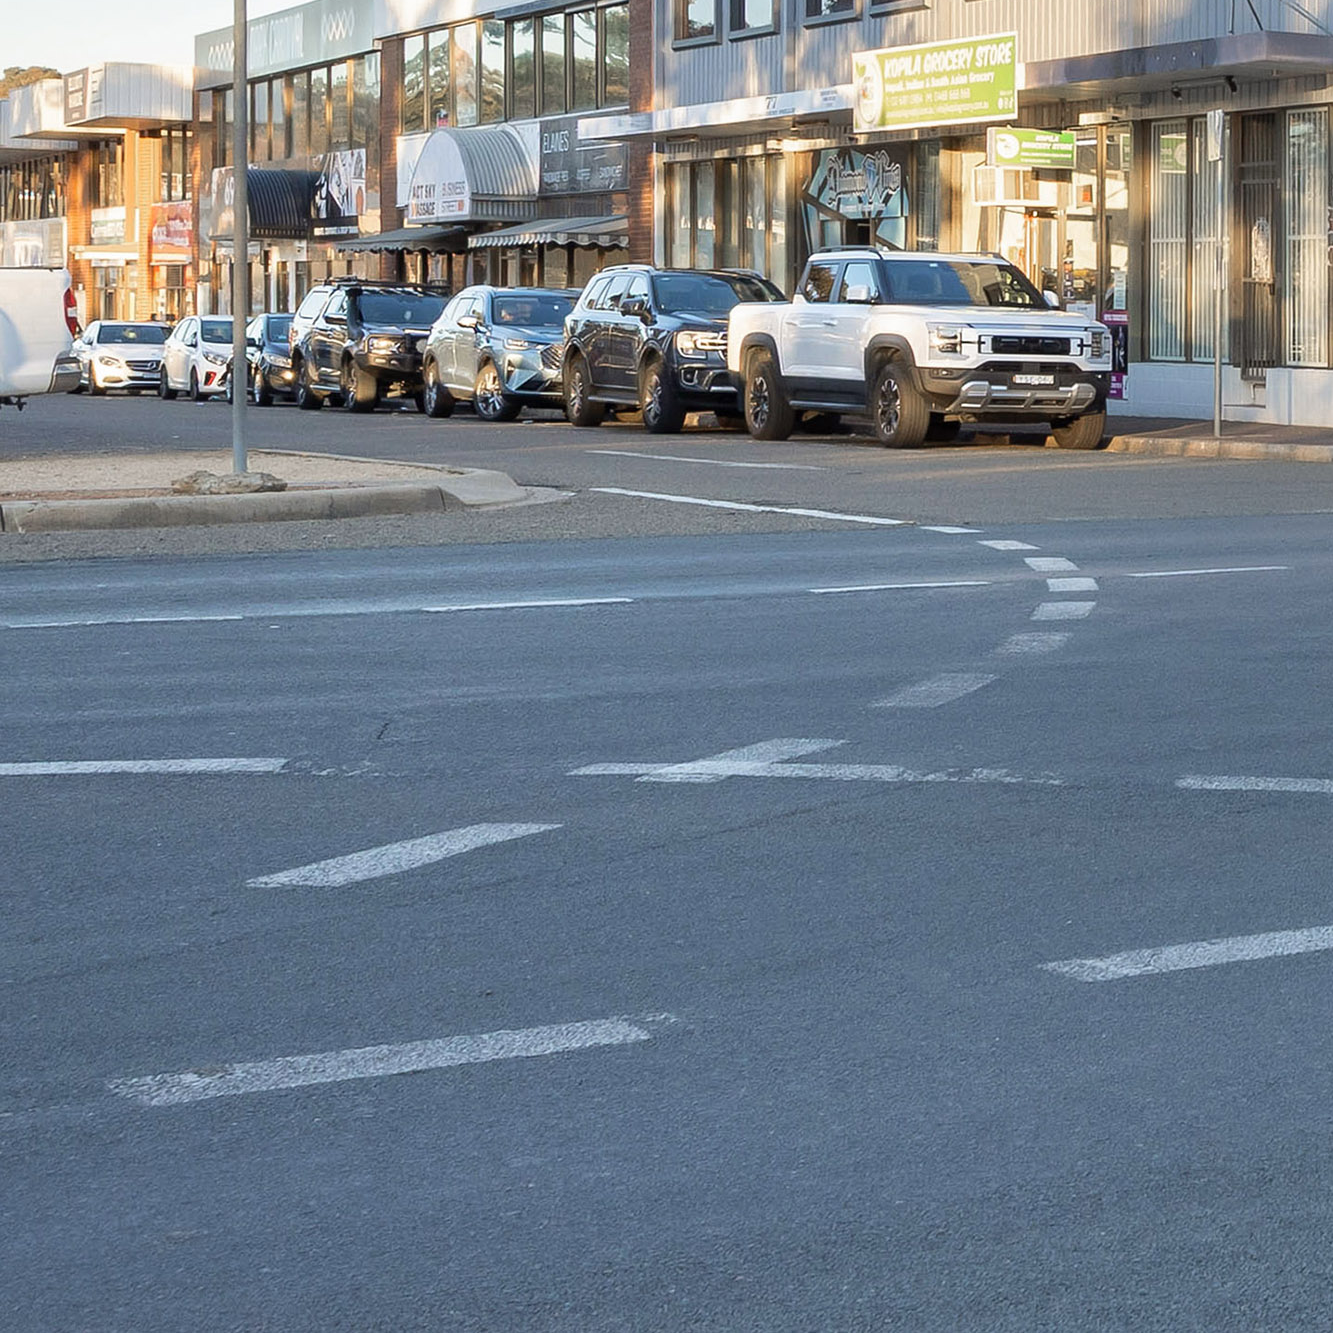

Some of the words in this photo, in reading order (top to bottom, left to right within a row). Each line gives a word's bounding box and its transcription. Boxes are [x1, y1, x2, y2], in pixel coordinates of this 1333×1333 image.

[884, 54, 922, 79] KOPILA
[923, 47, 973, 74] GROCERY
[975, 41, 1013, 68] STORE
